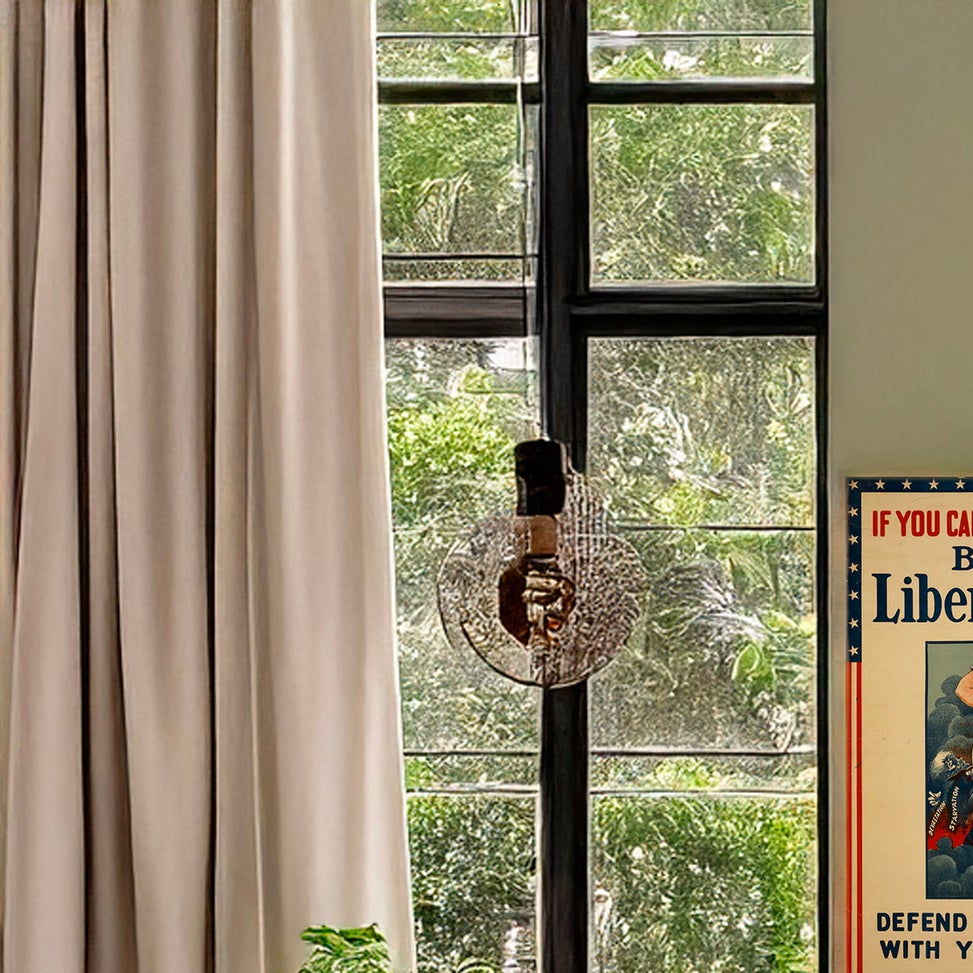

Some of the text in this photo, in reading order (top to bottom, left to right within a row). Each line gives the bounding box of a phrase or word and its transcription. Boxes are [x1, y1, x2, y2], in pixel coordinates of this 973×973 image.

[872, 510, 892, 537] IF
[896, 510, 940, 537] YOU
[948, 786, 960, 831] STARVATION
[876, 912, 967, 932] DEFEND
[880, 940, 940, 960] WITH
